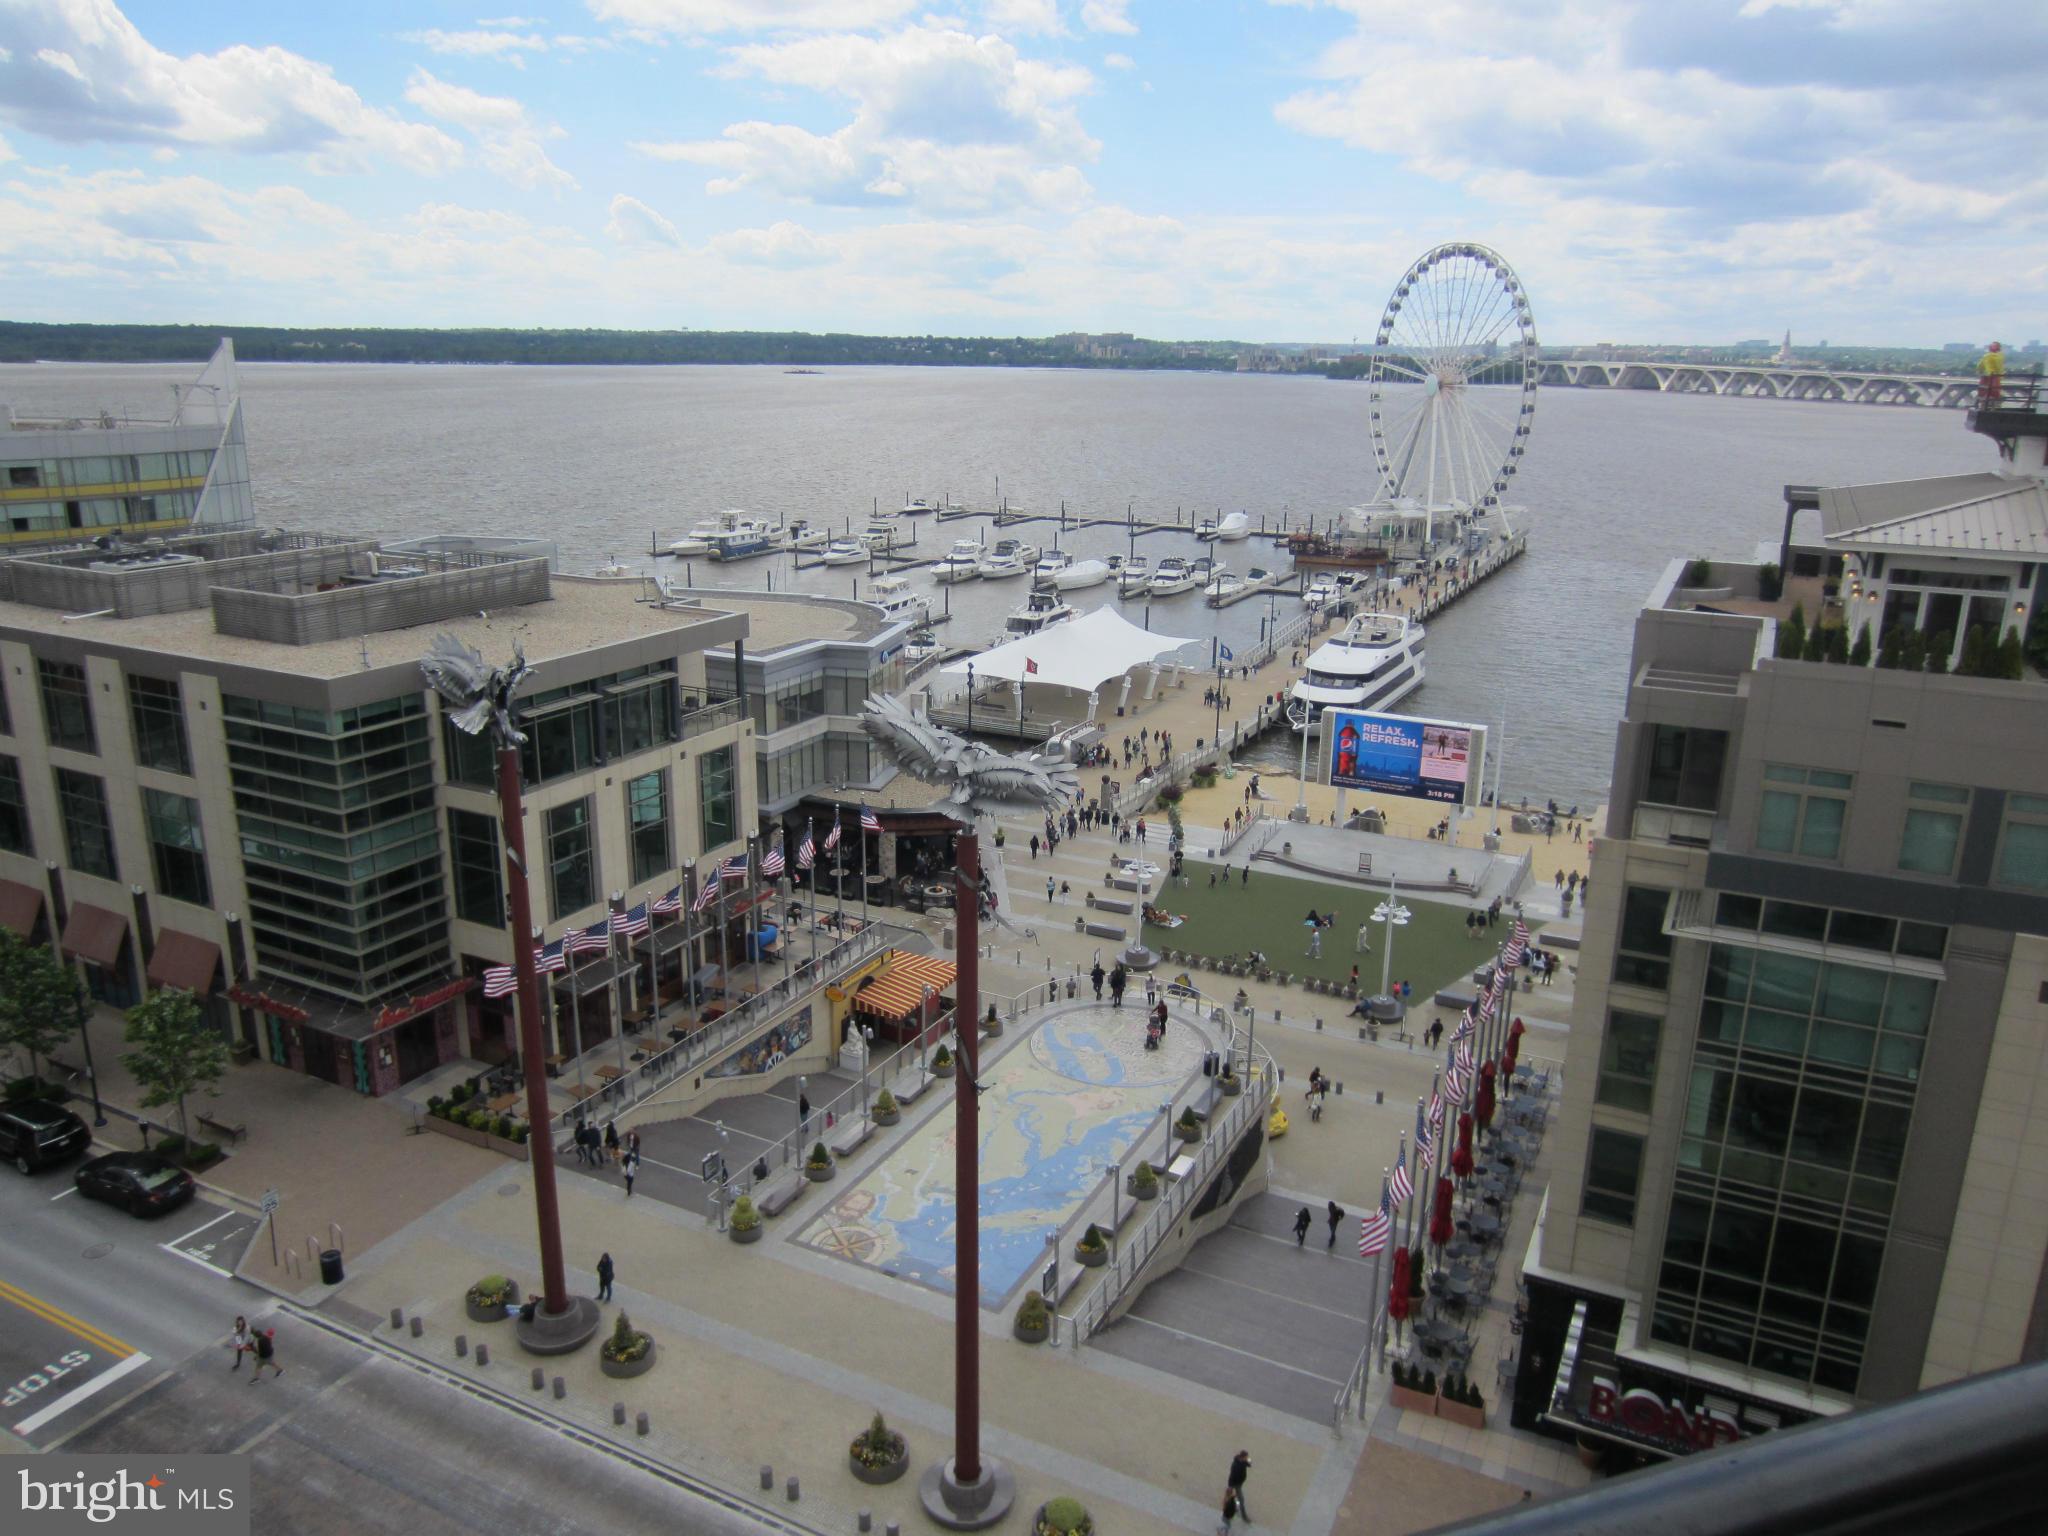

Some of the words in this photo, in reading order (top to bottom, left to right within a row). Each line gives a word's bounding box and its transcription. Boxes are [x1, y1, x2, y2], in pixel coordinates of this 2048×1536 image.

[1362, 732, 1419, 748] REFRESH.
[1363, 723, 1405, 736] RELAX.
[1, 1350, 91, 1407] STOP
[1589, 1376, 1740, 1449] BOND
